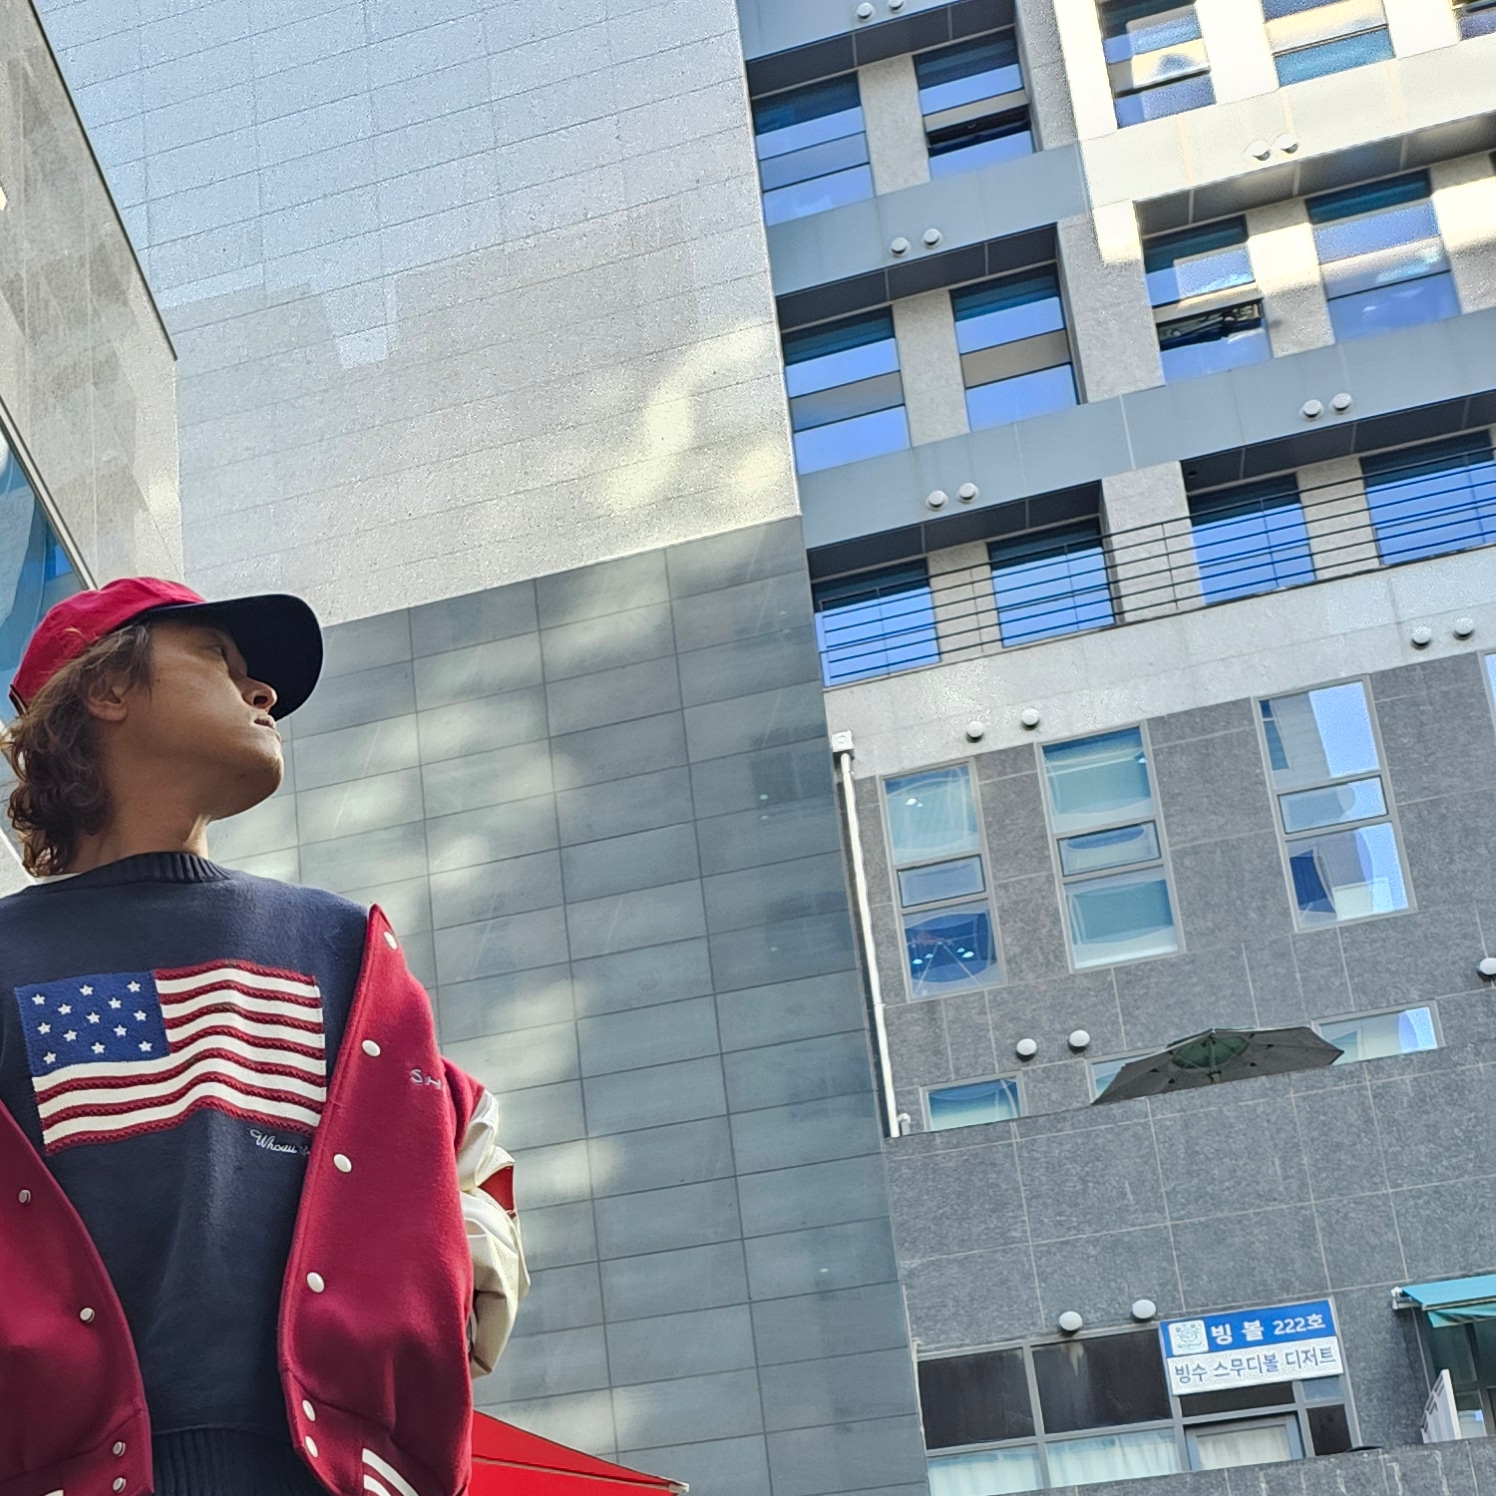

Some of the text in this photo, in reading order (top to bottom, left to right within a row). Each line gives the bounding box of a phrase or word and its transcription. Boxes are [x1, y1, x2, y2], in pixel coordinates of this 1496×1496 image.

[1210, 1312, 1326, 1345] 빙 볼 222호
[1175, 1346, 1337, 1384] 빙수 스무디볼 디저트
